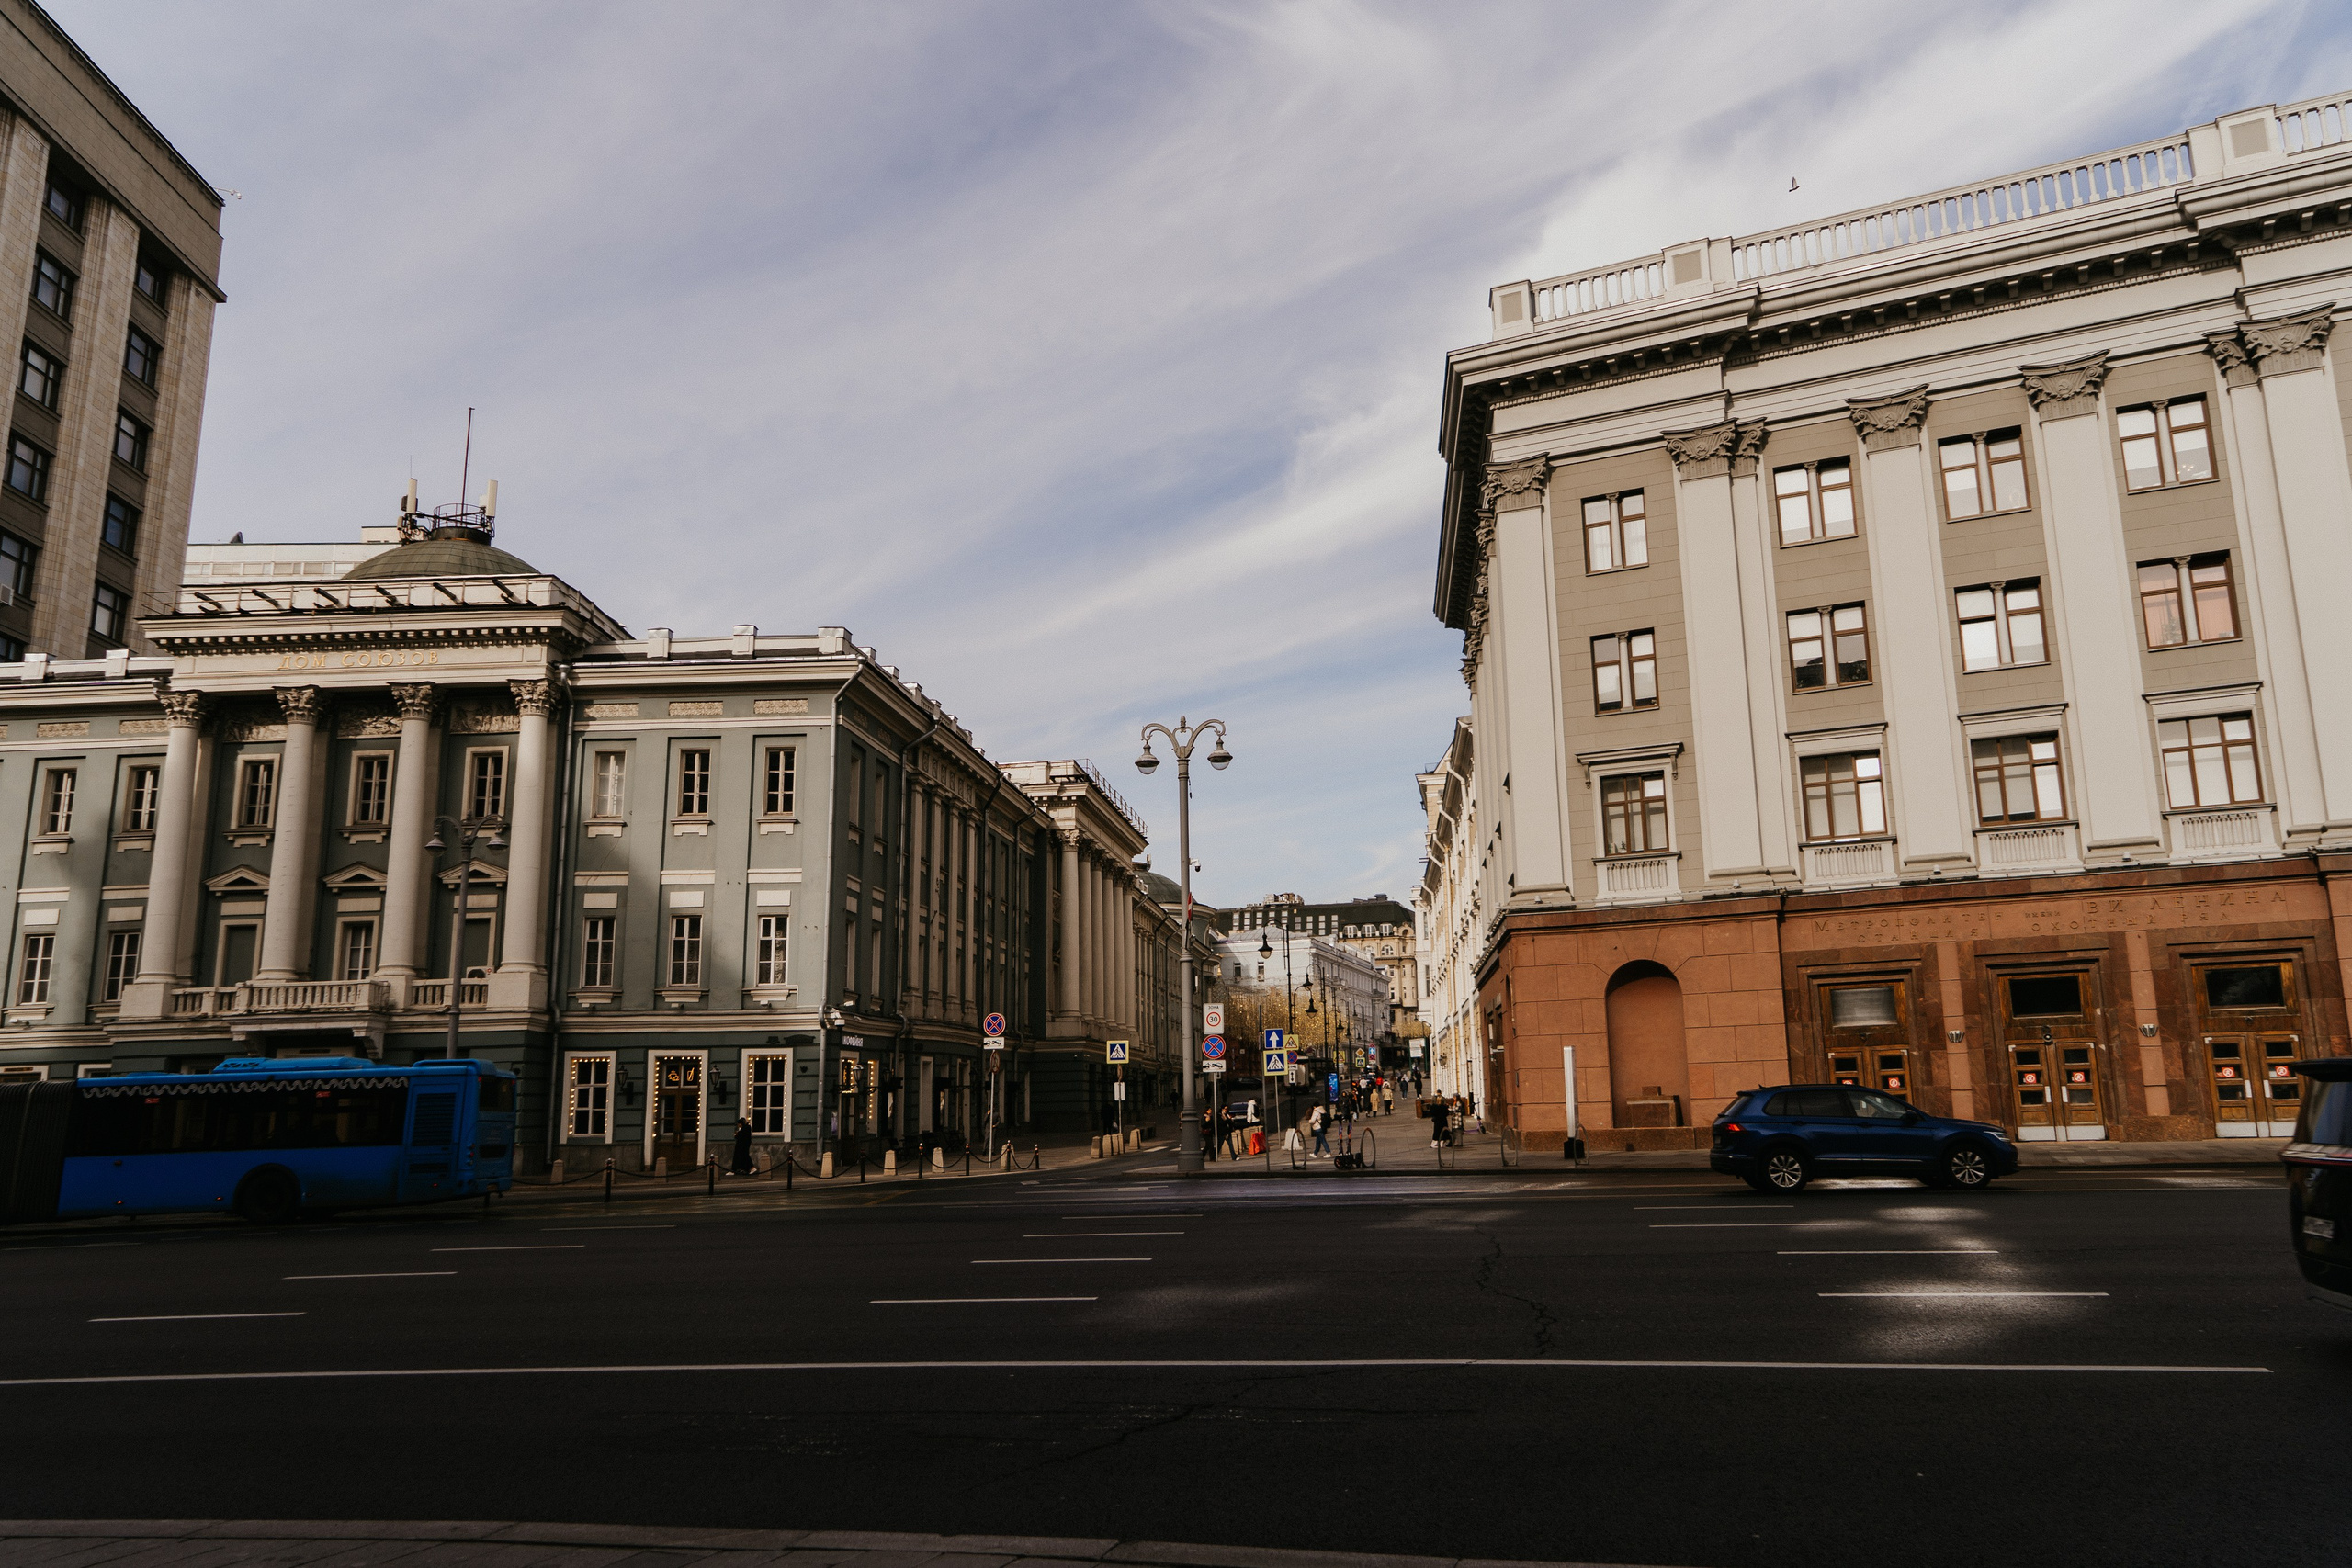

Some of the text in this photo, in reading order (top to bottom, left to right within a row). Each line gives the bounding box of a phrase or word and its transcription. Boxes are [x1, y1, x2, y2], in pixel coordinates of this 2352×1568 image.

[277, 650, 439, 671] ДОМ СОЮЗОВ
[1814, 910, 2005, 933] МЕТРОПОЛИТЕН
[2149, 890, 2287, 910] ЛЕНИНА
[1857, 911, 2231, 944] СТАНЦИЯ ОХОТНЫЙ РЯД
